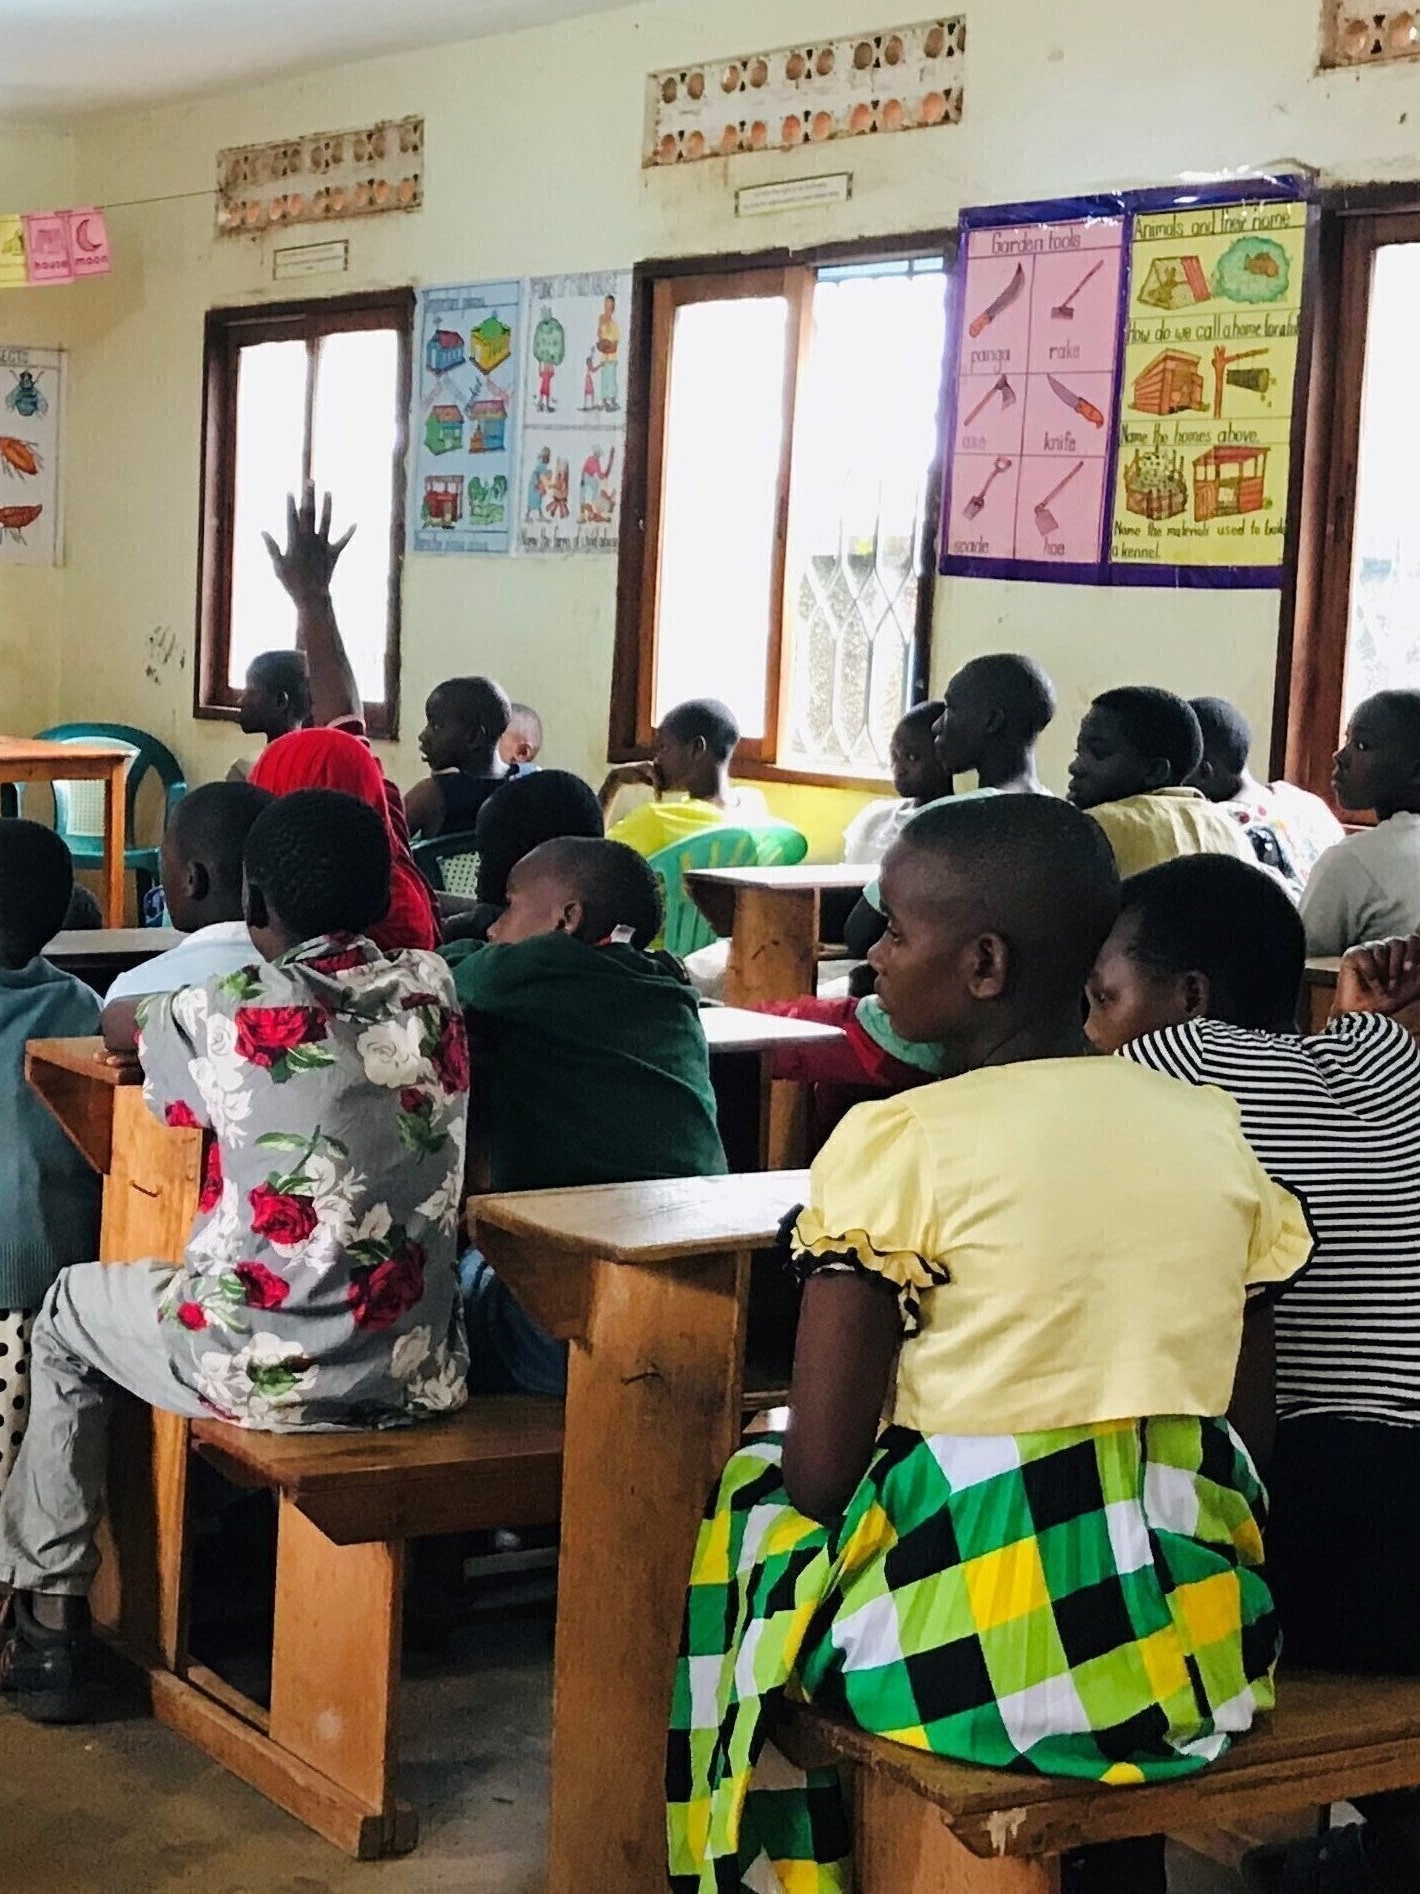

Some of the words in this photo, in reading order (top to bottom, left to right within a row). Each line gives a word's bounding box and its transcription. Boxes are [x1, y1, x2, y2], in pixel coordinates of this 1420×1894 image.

[1134, 212, 1183, 240] Animals
[1191, 210, 1215, 235] and
[992, 232, 1043, 254] Garden
[1048, 227, 1081, 249] tools
[75, 254, 108, 266] moon
[1128, 319, 1150, 342] How
[1155, 318, 1171, 341] do
[1175, 326, 1192, 341] we
[1196, 313, 1221, 339] call
[1232, 314, 1262, 337] home
[1048, 339, 1081, 359] rake
[971, 349, 1011, 373] panga
[962, 435, 986, 449] axe
[1043, 431, 1076, 451] knife
[1120, 423, 1148, 445] Name
[1153, 422, 1168, 444] the
[1175, 420, 1212, 444] homes
[1217, 421, 1260, 444] above.
[1114, 520, 1141, 537] Name
[1147, 520, 1162, 537] the
[1217, 518, 1245, 537] used
[1251, 519, 1261, 536] to
[954, 535, 989, 554] spade
[1043, 538, 1065, 555] hoe
